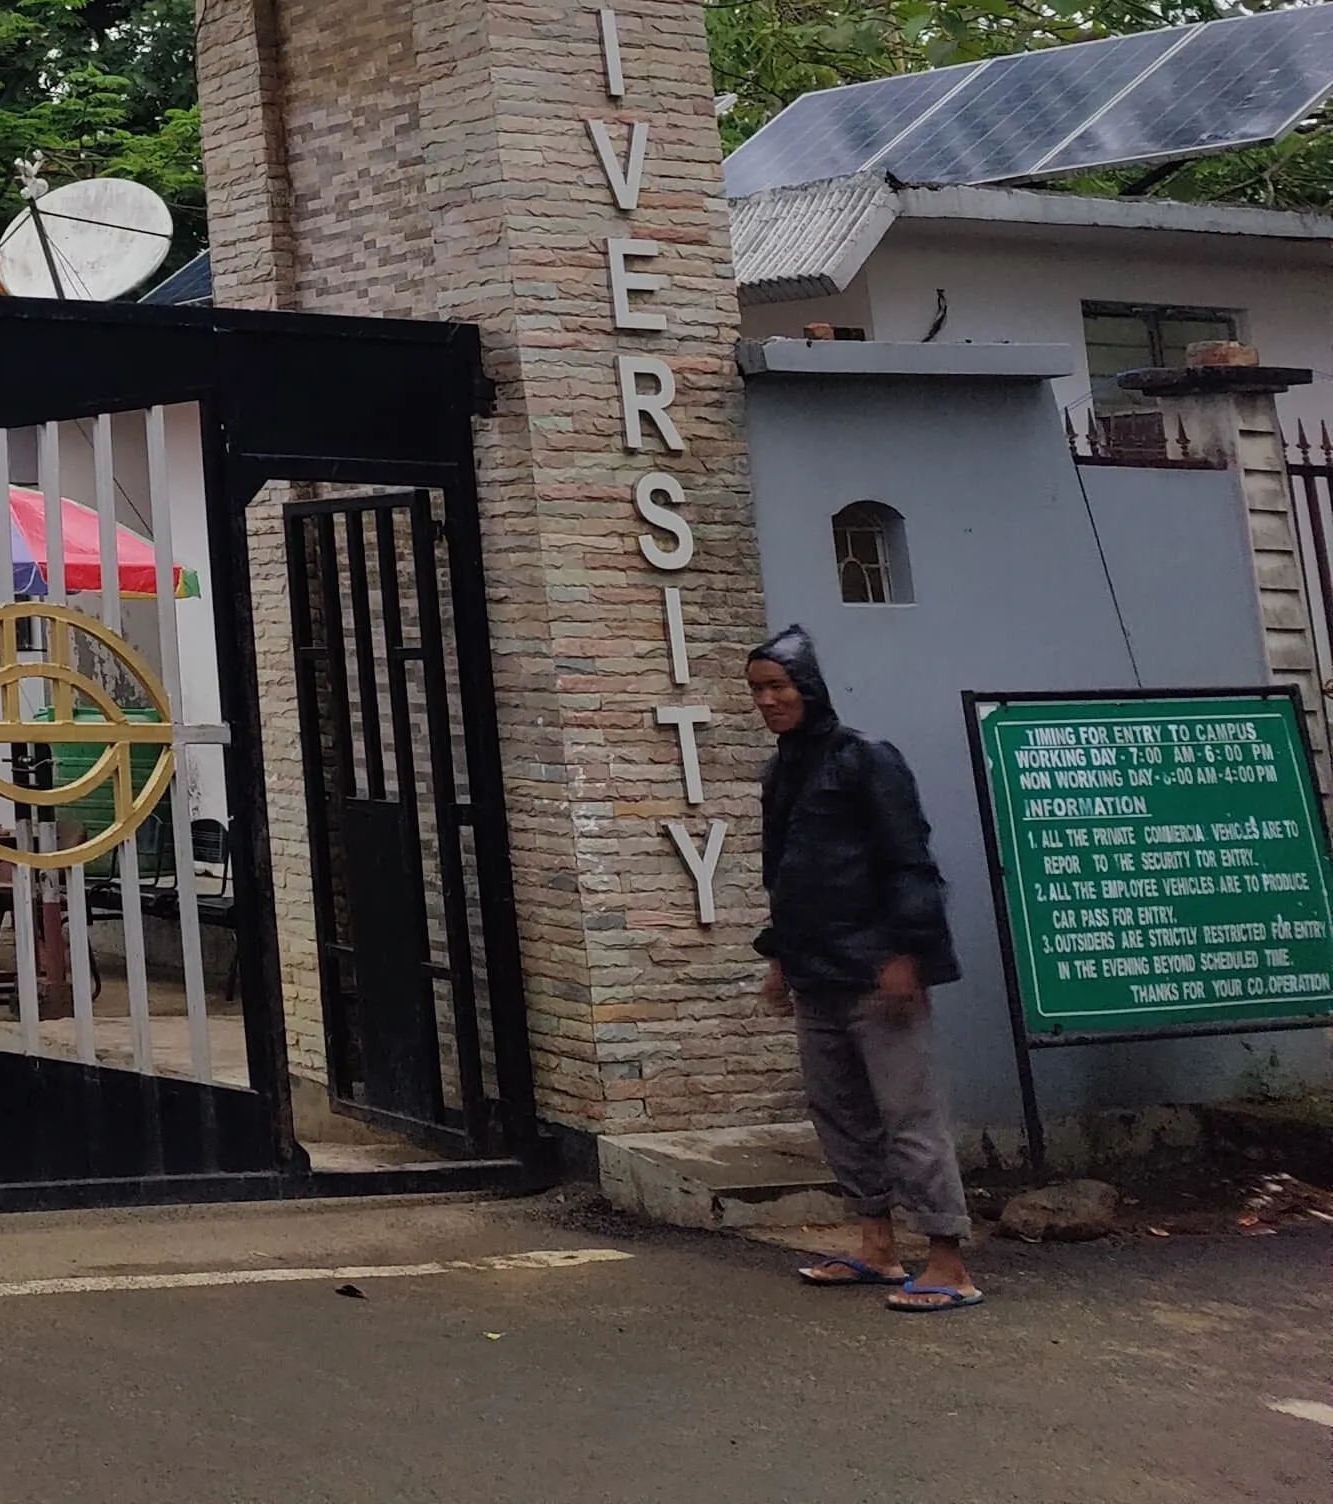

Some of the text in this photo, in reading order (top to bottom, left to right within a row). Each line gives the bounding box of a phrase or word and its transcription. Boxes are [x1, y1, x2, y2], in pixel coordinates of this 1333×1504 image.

[1025, 722, 1257, 746] TIMING FOR ENTRY TO CAMPUS
[1014, 749, 1087, 768] WORKING
[1252, 744, 1274, 761] PM
[1019, 771, 1051, 790] NON
[1054, 769, 1123, 789] WORKING
[1256, 765, 1278, 782] PM
[1025, 796, 1148, 817] INFORMATION
[1042, 829, 1063, 848] ALL
[1066, 828, 1089, 847] THE
[1093, 827, 1136, 846] PRIVATE
[1144, 824, 1208, 844] COMMERCIA
[1262, 820, 1283, 839] ARE
[1283, 820, 1299, 838] TO
[1093, 854, 1108, 872] TO
[1141, 850, 1190, 871] SECURITY
[1035, 873, 1309, 902] 2. ALL THE EMPLOYEE VEHICLES ARE TO PRODUCE
[1053, 905, 1177, 929] CAR PASS FOR ENTRY.
[1042, 919, 1326, 954] 3. OUTSIDERS ARE STRICTLY RESTRICTED FOR ENTRY
[1057, 961, 1070, 980] IN
[1074, 959, 1097, 979] THE
[1102, 956, 1150, 977] EVENING
[1152, 954, 1196, 974] BEYOND
[1200, 950, 1259, 971] SCHEDULED
[1129, 982, 1179, 1003] THANKS
[1183, 981, 1205, 1000] FOR
[1211, 978, 1243, 998] YOUR
